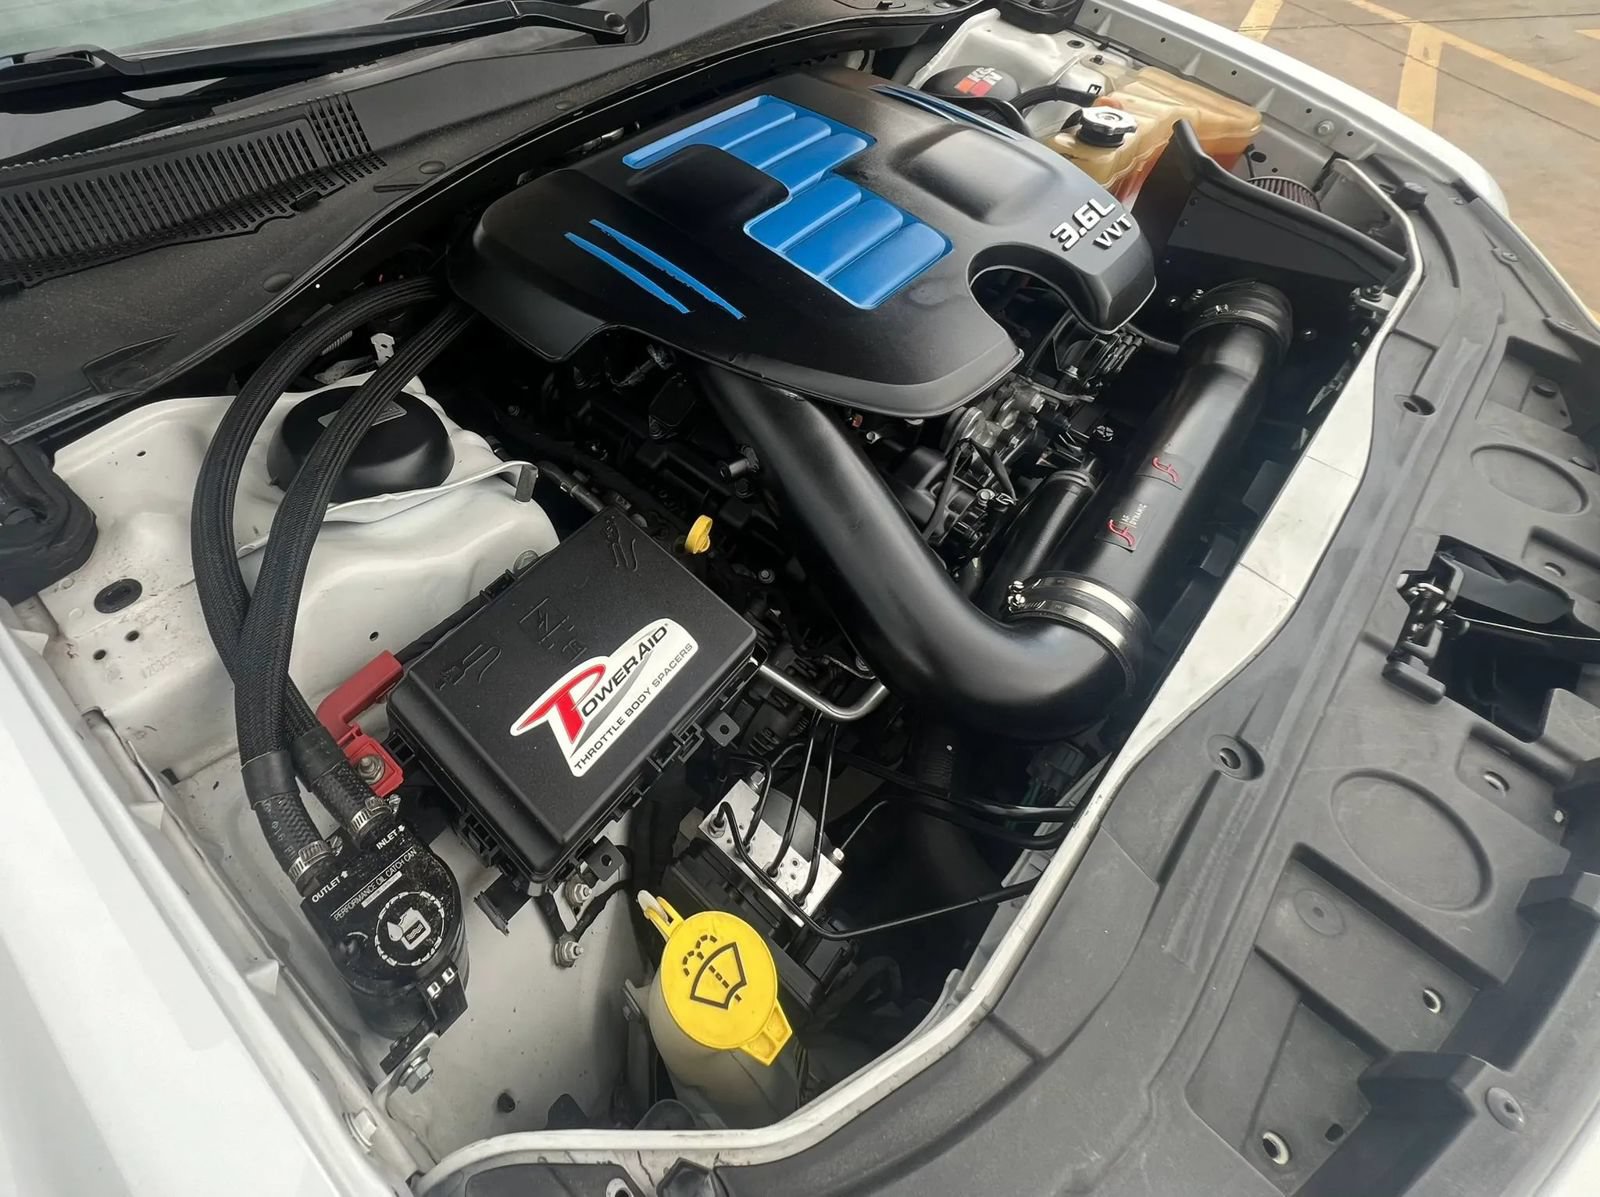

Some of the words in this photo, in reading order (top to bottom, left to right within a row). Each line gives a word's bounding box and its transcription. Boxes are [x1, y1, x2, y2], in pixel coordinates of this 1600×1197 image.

[1050, 198, 1116, 251] 3.6L
[1093, 213, 1132, 250] VVT
[574, 717, 625, 770] THROTTLE
[625, 687, 651, 718] BODY
[652, 643, 693, 688] SPACERS
[376, 829, 398, 850] INLET
[311, 875, 342, 903] OUTLET
[333, 883, 376, 921] PERFORMANCE
[376, 873, 386, 886] OIL
[386, 859, 405, 878] CATCH
[403, 849, 417, 863] CAN
